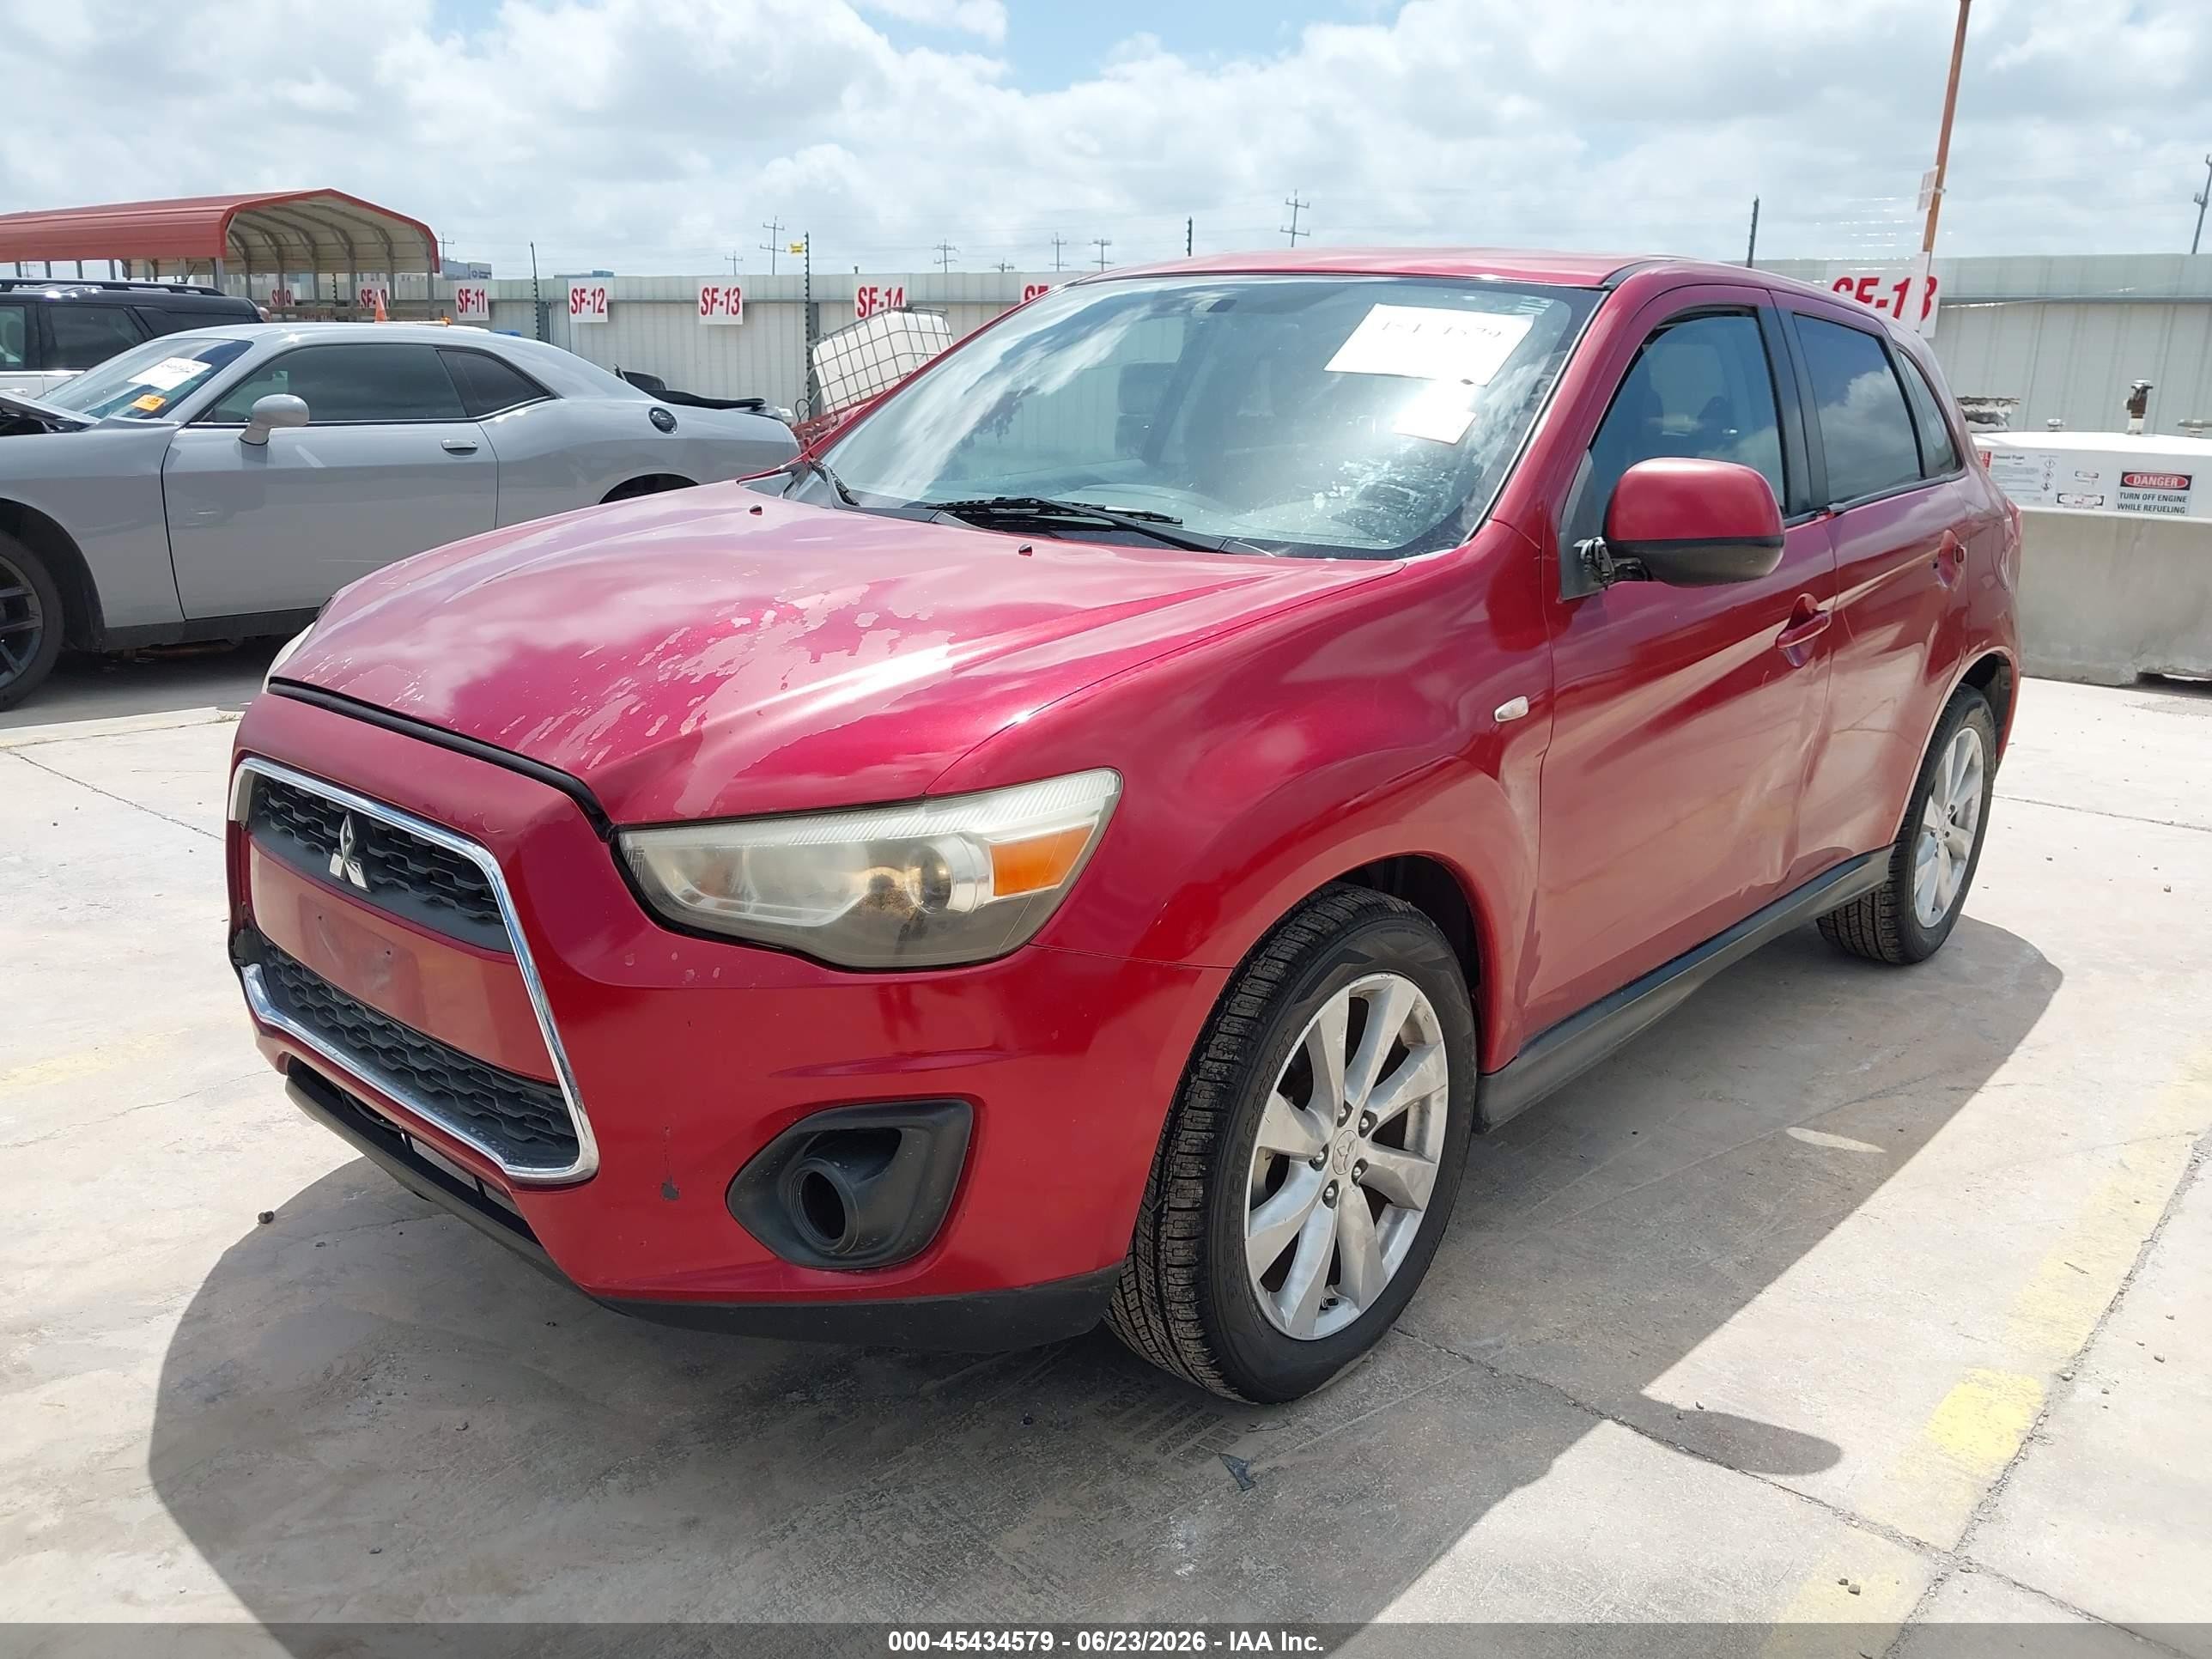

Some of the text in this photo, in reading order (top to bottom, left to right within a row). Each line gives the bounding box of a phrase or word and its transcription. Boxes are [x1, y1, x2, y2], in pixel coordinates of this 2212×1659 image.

[457, 289, 486, 313] SF-11
[570, 288, 605, 314] SF-12
[700, 287, 740, 315] SF-13
[856, 286, 904, 318] SF-14
[2133, 474, 2179, 488] DANGER
[2117, 502, 2186, 514] WHILE REFUELING
[2119, 492, 2188, 503] TURN OFF ENGINE
